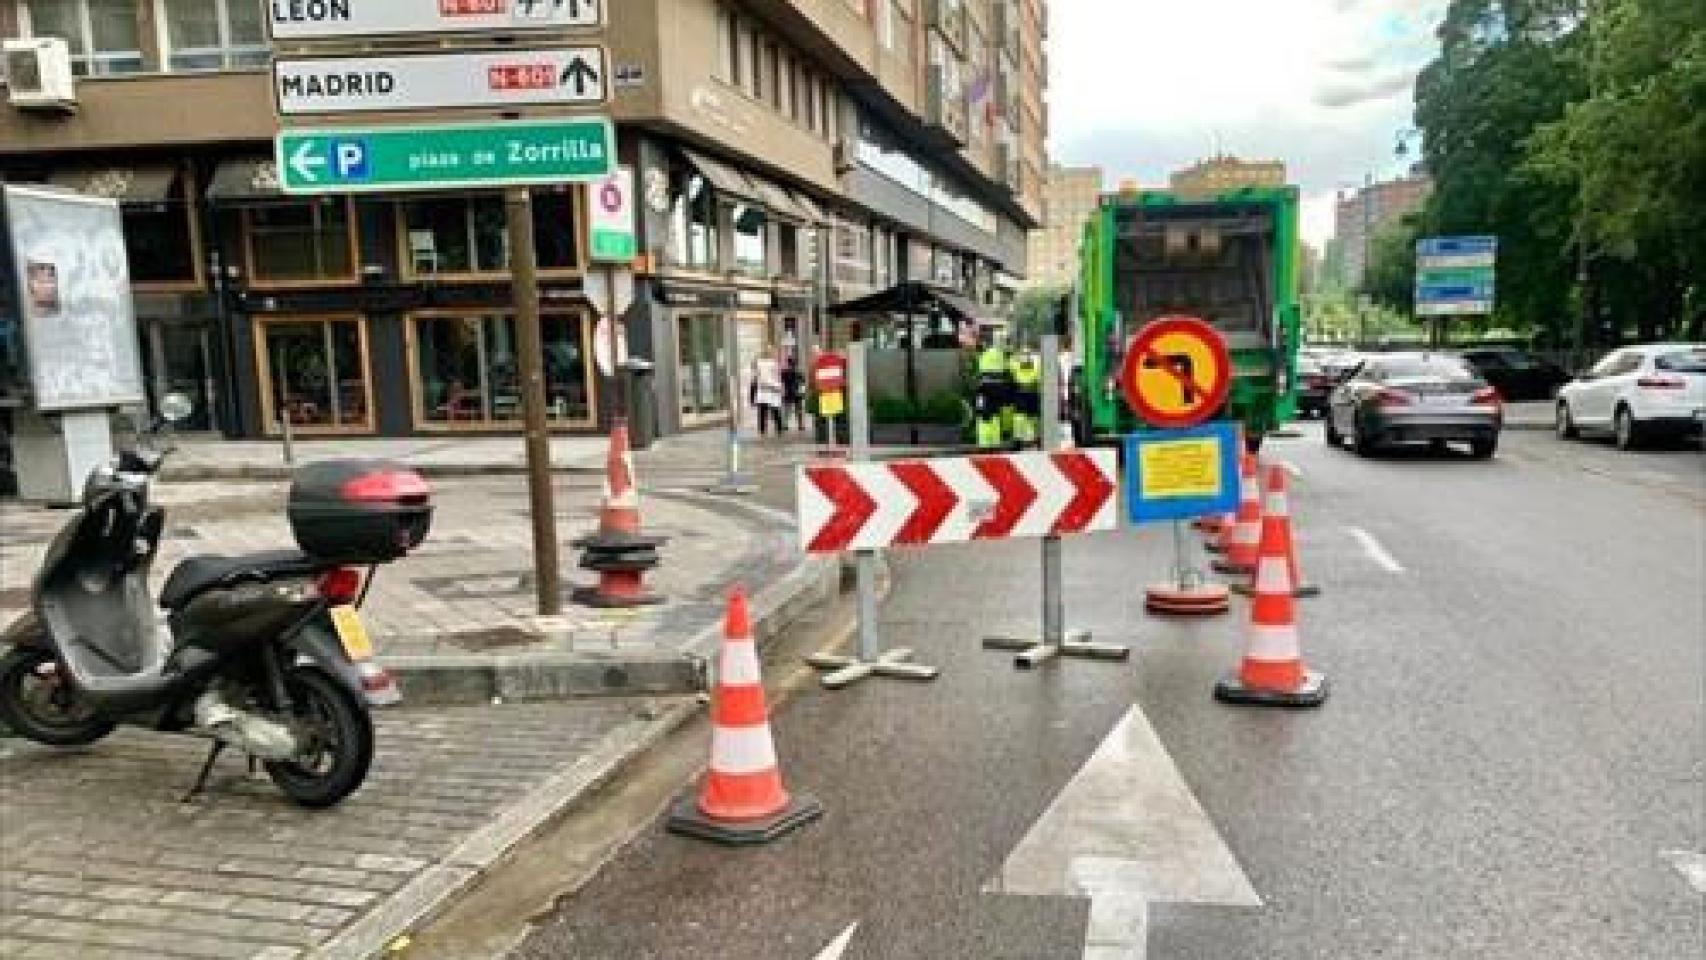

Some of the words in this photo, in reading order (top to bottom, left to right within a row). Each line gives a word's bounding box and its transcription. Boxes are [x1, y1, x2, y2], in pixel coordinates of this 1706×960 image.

[282, 72, 395, 96] MADRID
[337, 144, 363, 175] P
[506, 136, 604, 165] Zorrilla
